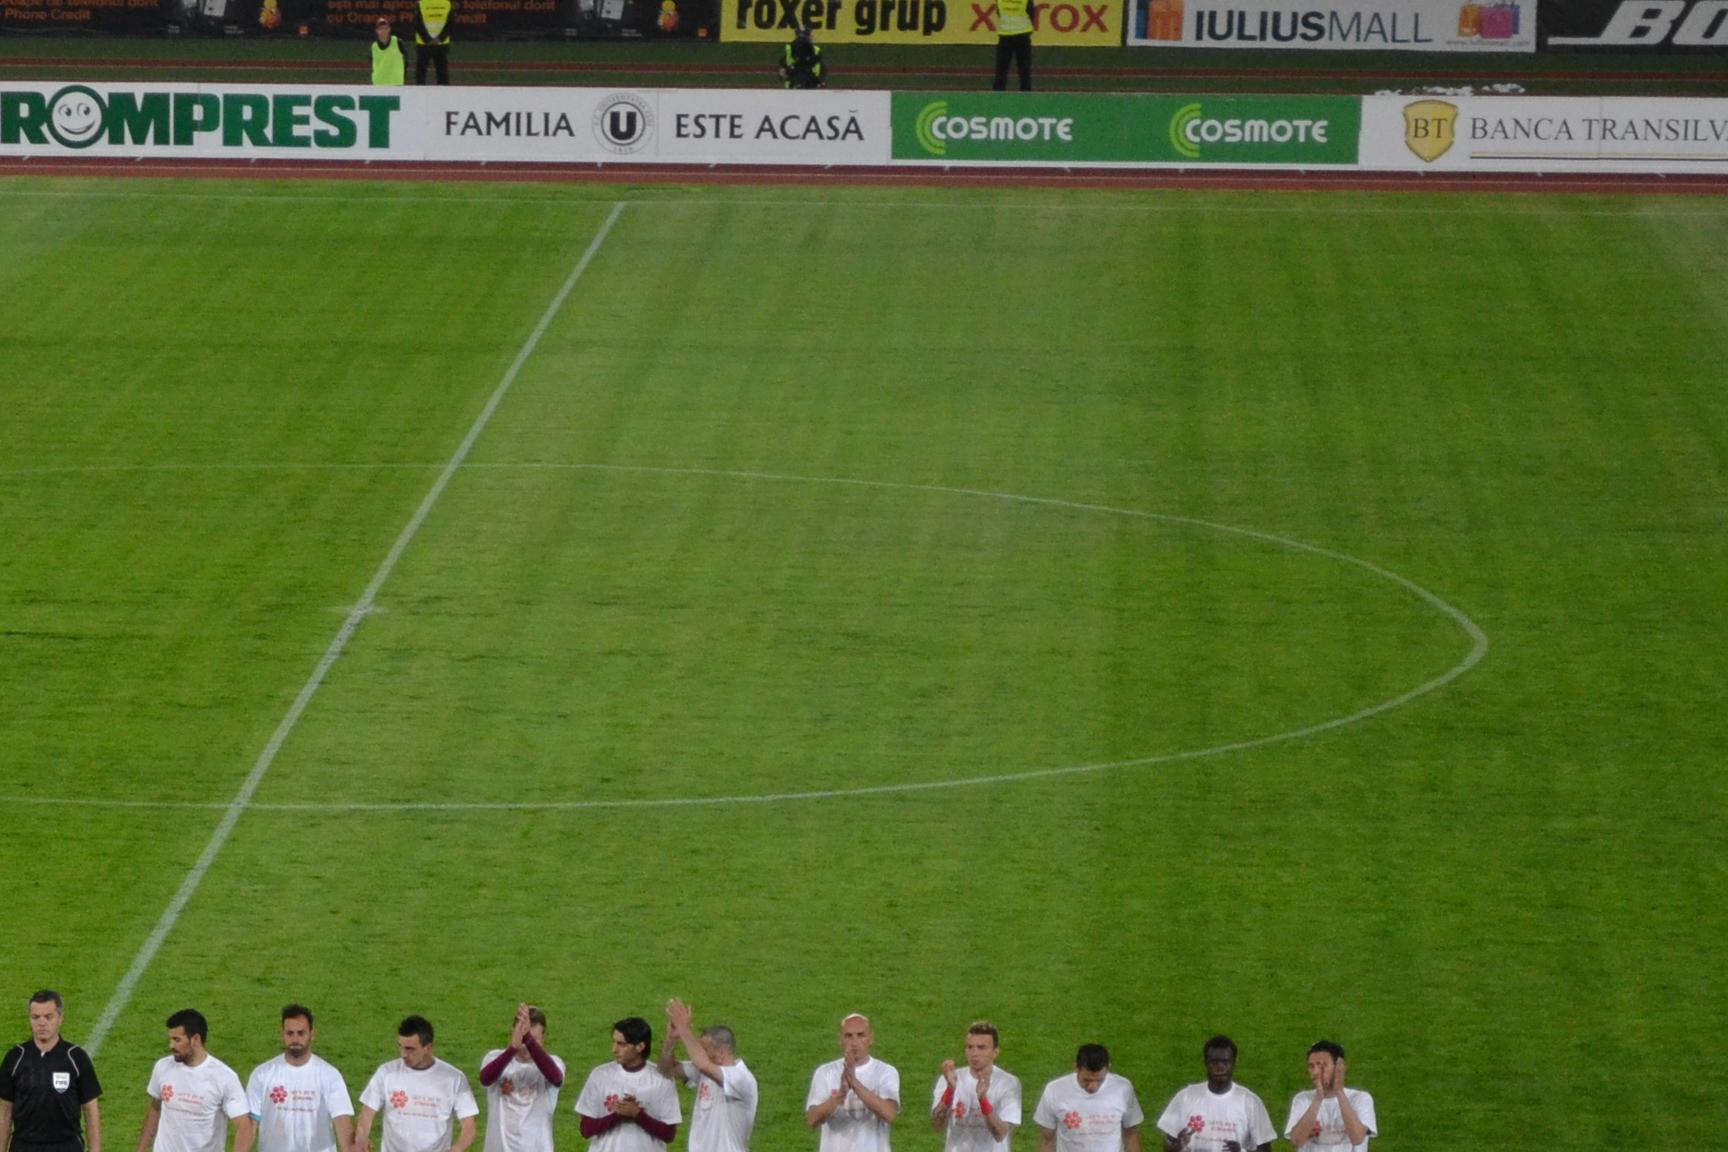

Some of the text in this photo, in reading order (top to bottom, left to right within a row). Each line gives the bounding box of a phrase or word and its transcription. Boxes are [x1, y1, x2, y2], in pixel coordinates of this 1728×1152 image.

[5, 9, 48, 20] Phone
[51, 10, 91, 20] Credit
[855, 2, 947, 36] grup
[969, 3, 1110, 33] xrox
[0, 85, 400, 149] ROMPREST
[444, 110, 575, 137] FAMILIA
[609, 110, 637, 141] U
[675, 109, 864, 141] ESTE ACASĂ
[931, 115, 1073, 141] COSMOTE
[1412, 117, 1448, 140] BT
[1470, 117, 1728, 142] BANCA TRANSILV
[1185, 118, 1328, 144] COSMOTE
